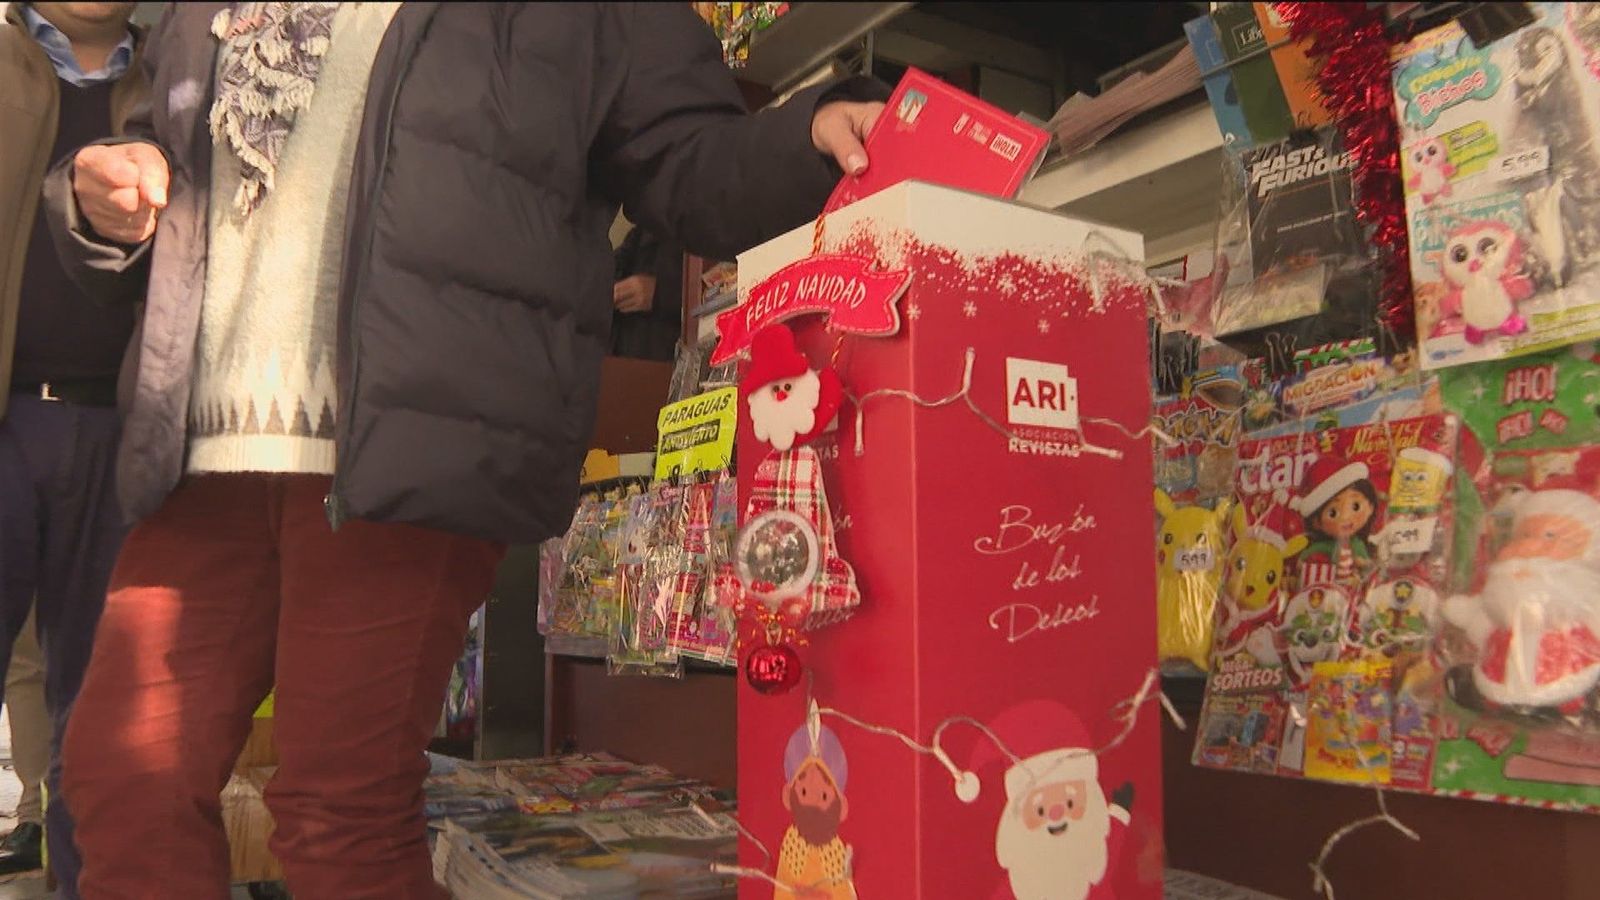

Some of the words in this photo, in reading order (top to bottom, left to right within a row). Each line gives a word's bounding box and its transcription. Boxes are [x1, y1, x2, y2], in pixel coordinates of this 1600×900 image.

[1251, 145, 1317, 184] FAST
[746, 281, 790, 332] FELIZ
[793, 272, 866, 309] NAVIDAD
[662, 393, 732, 428] PARAGUAS
[1013, 377, 1067, 411] ARI
[1008, 437, 1080, 458] REVISTAS
[974, 503, 1096, 555] Buzón
[1012, 561, 1038, 590] de
[1046, 545, 1081, 581] los
[989, 594, 1099, 643] Deseos
[1212, 667, 1284, 691] SORTEOS
